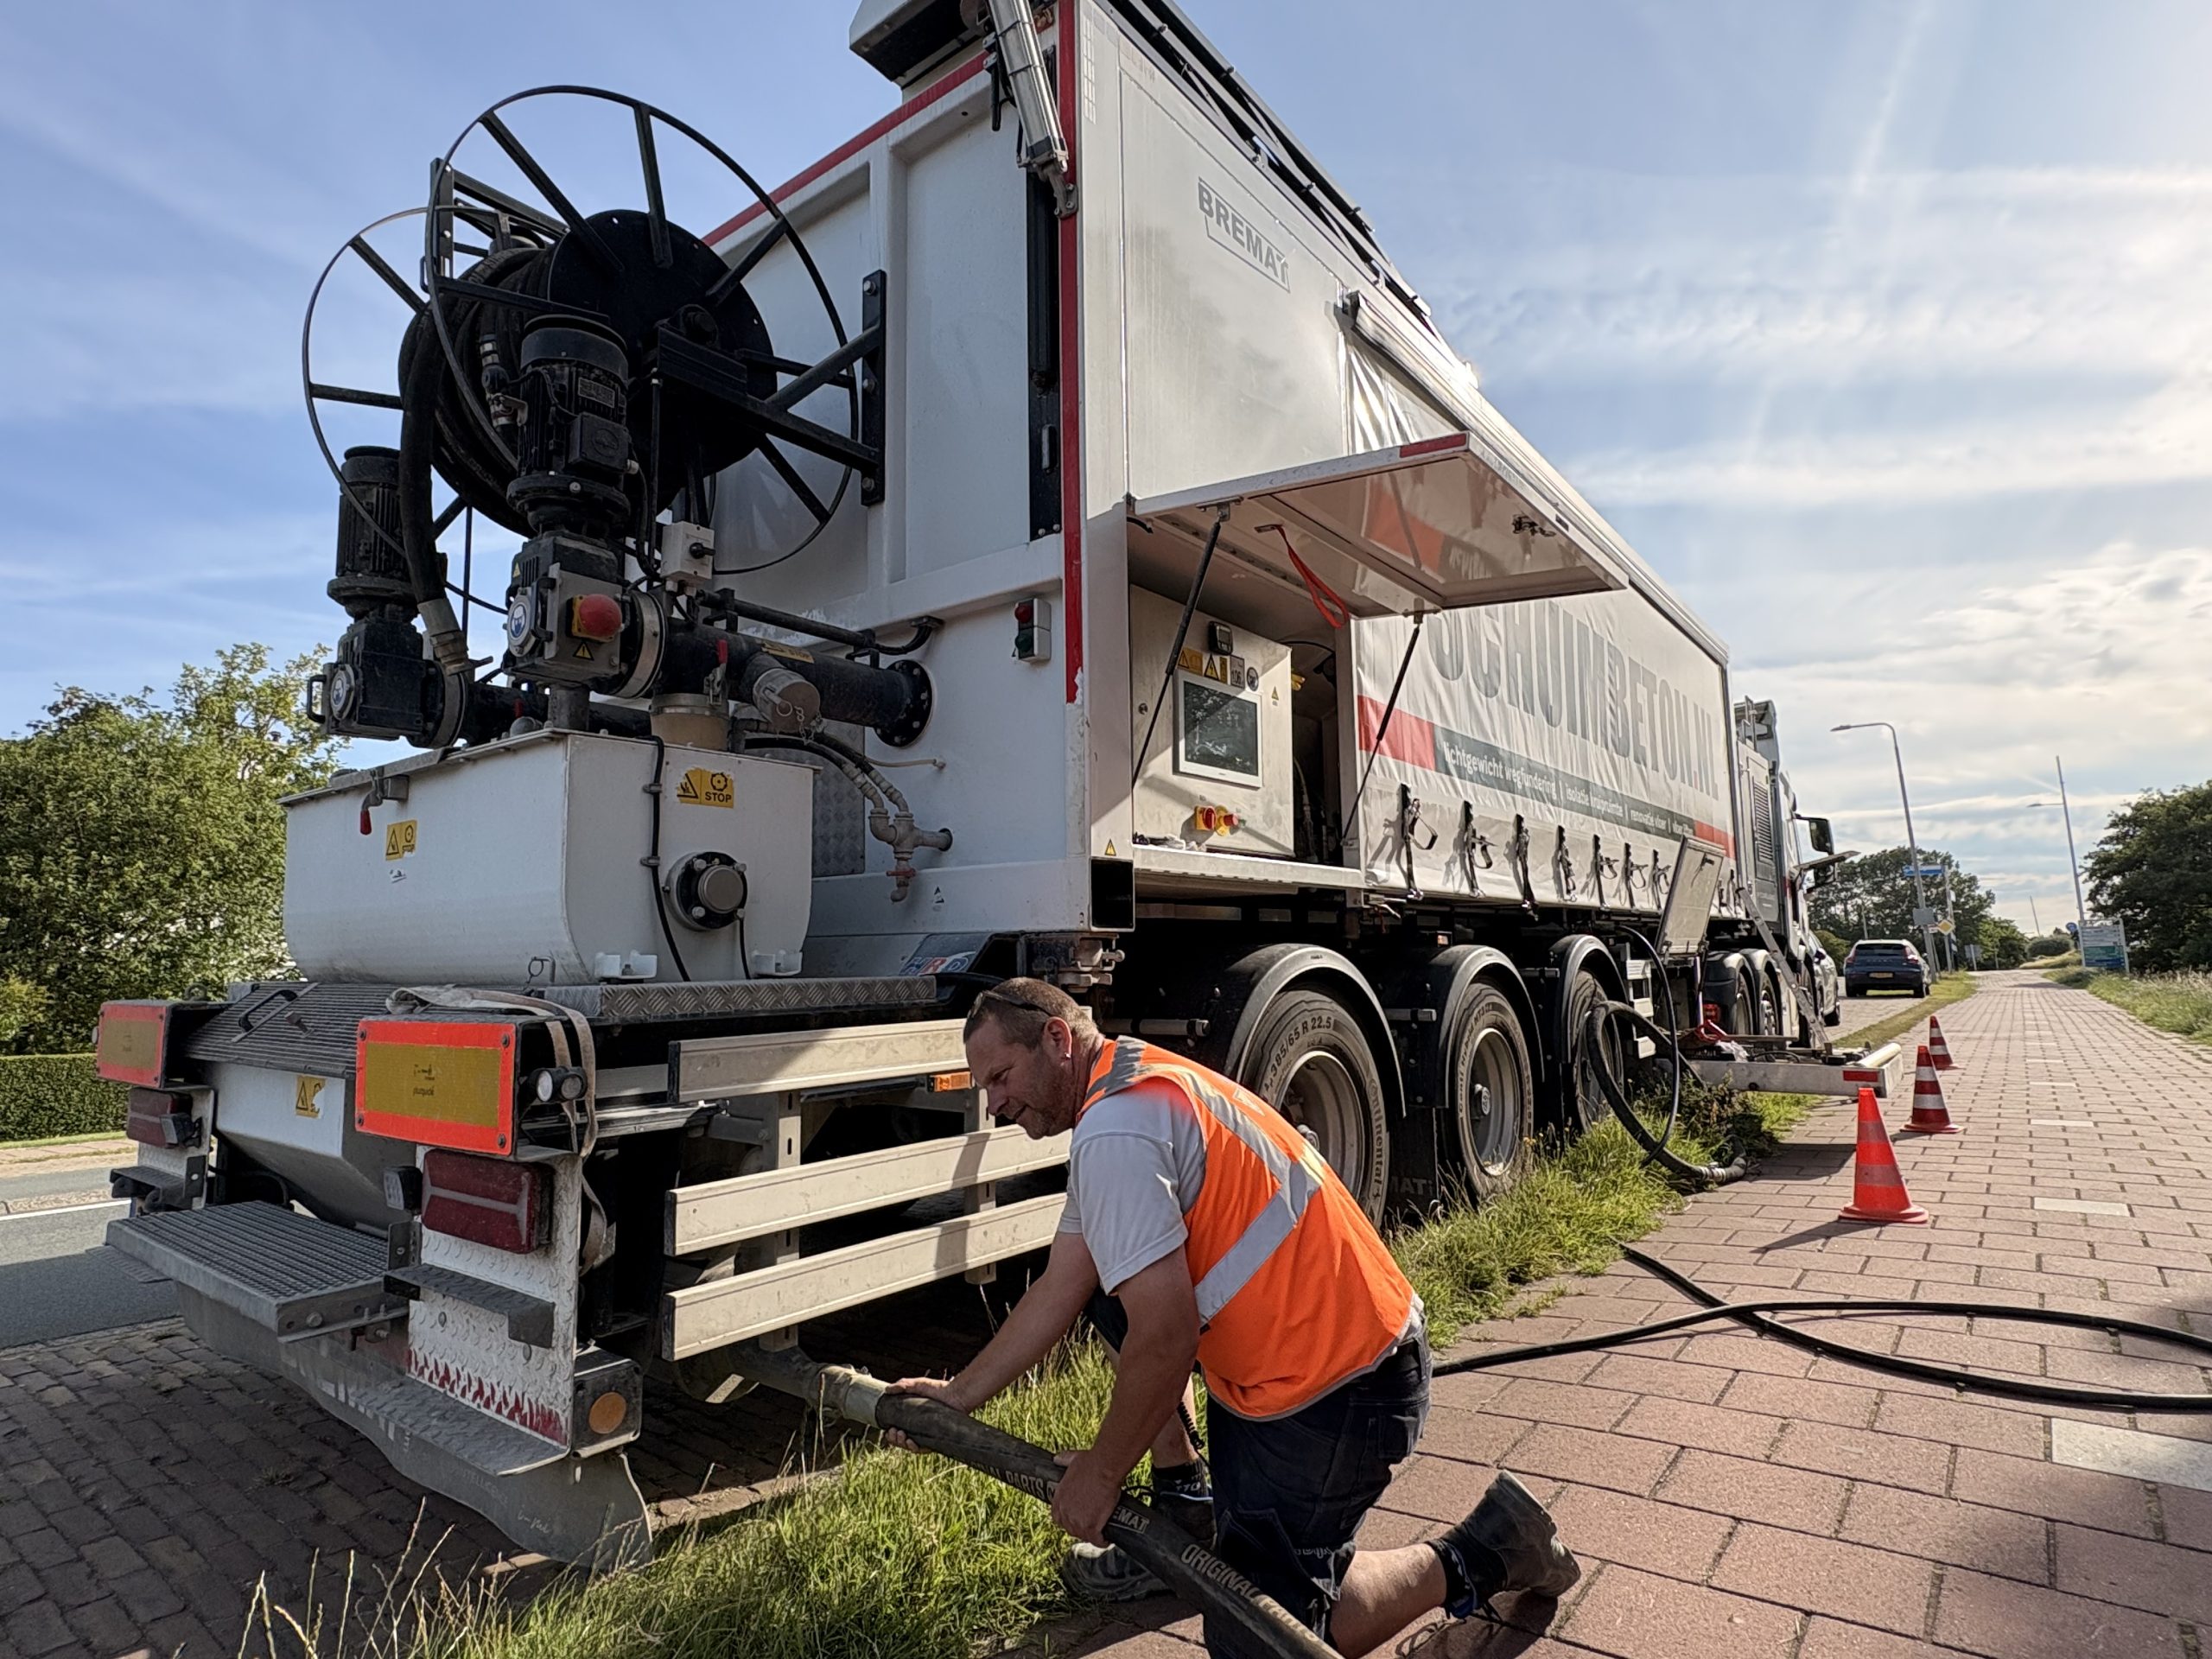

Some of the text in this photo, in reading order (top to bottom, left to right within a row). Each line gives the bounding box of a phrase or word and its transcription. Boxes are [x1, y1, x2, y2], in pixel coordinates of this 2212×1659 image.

[1198, 182, 1289, 284] BREMAT
[1444, 741, 1503, 779] lichtgewicht
[705, 791, 732, 803] STOP
[1311, 1015, 1332, 1030] 22.5
[1006, 1471, 1045, 1500] PARTS
[1112, 1506, 1148, 1530] EMAT
[1181, 1543, 1261, 1599] ORIGINAL
